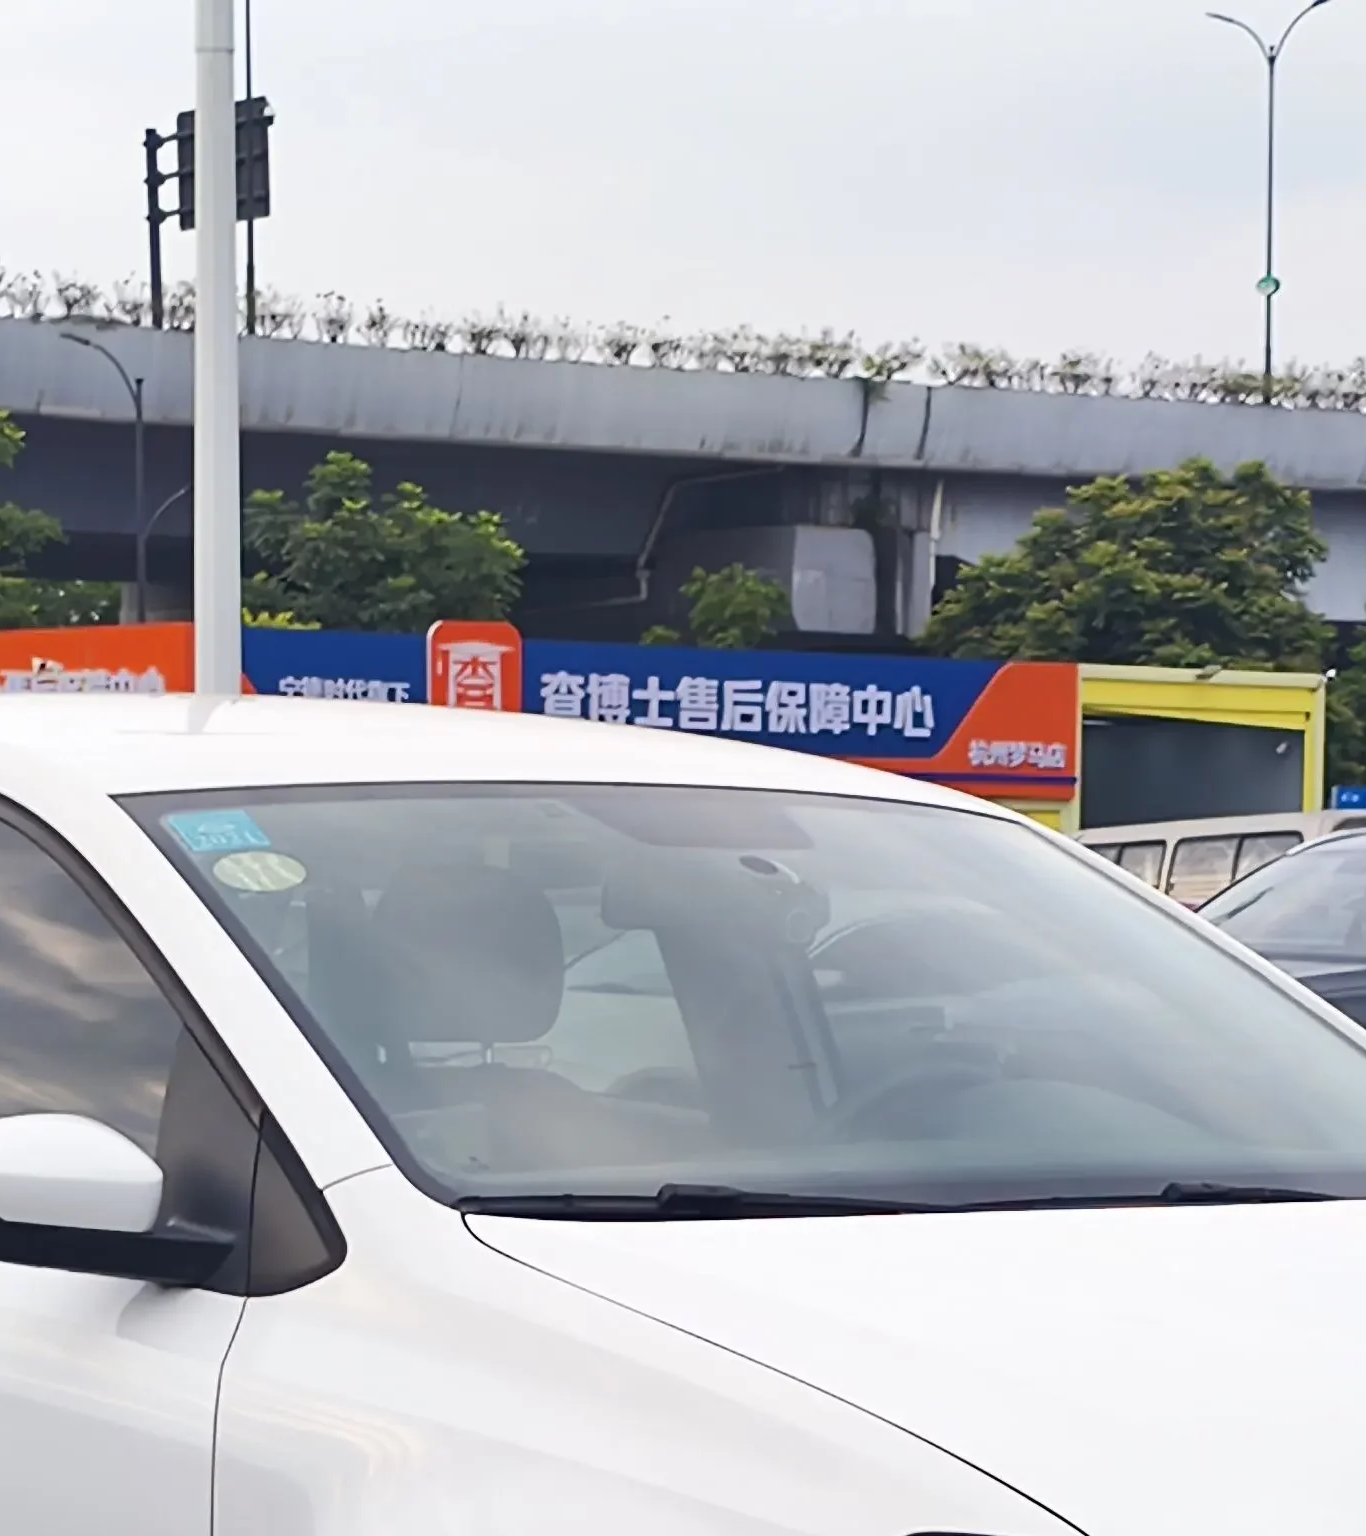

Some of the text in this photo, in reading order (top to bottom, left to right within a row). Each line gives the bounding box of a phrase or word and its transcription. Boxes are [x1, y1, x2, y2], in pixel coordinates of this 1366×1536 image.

[541, 670, 934, 738] 查博士售后保障中心
